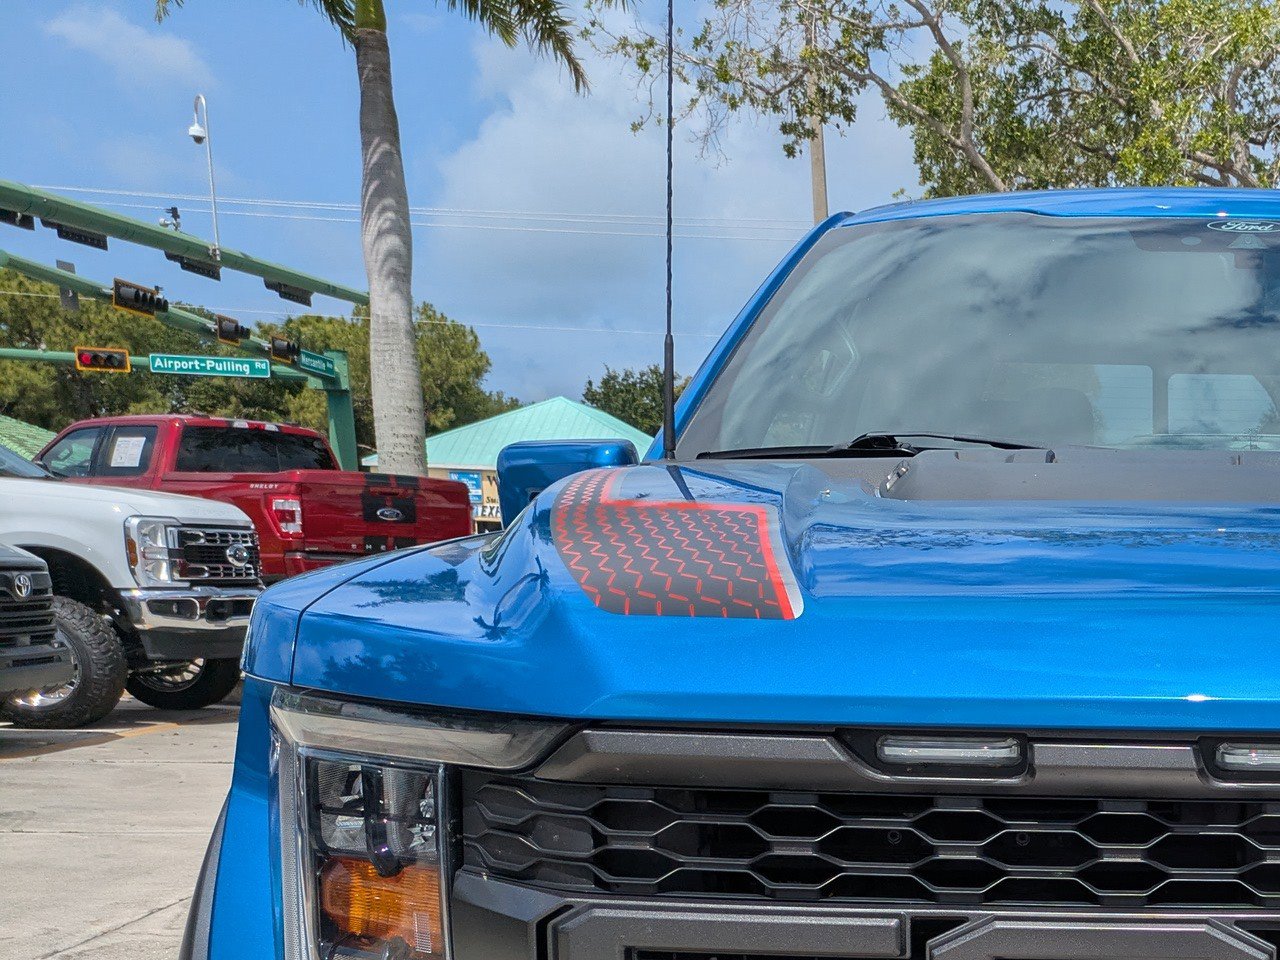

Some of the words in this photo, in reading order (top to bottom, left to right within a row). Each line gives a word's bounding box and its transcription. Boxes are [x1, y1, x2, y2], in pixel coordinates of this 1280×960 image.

[1221, 220, 1274, 231] Ford
[154, 357, 250, 375] Airport-Pulling
[255, 361, 266, 370] Rd
